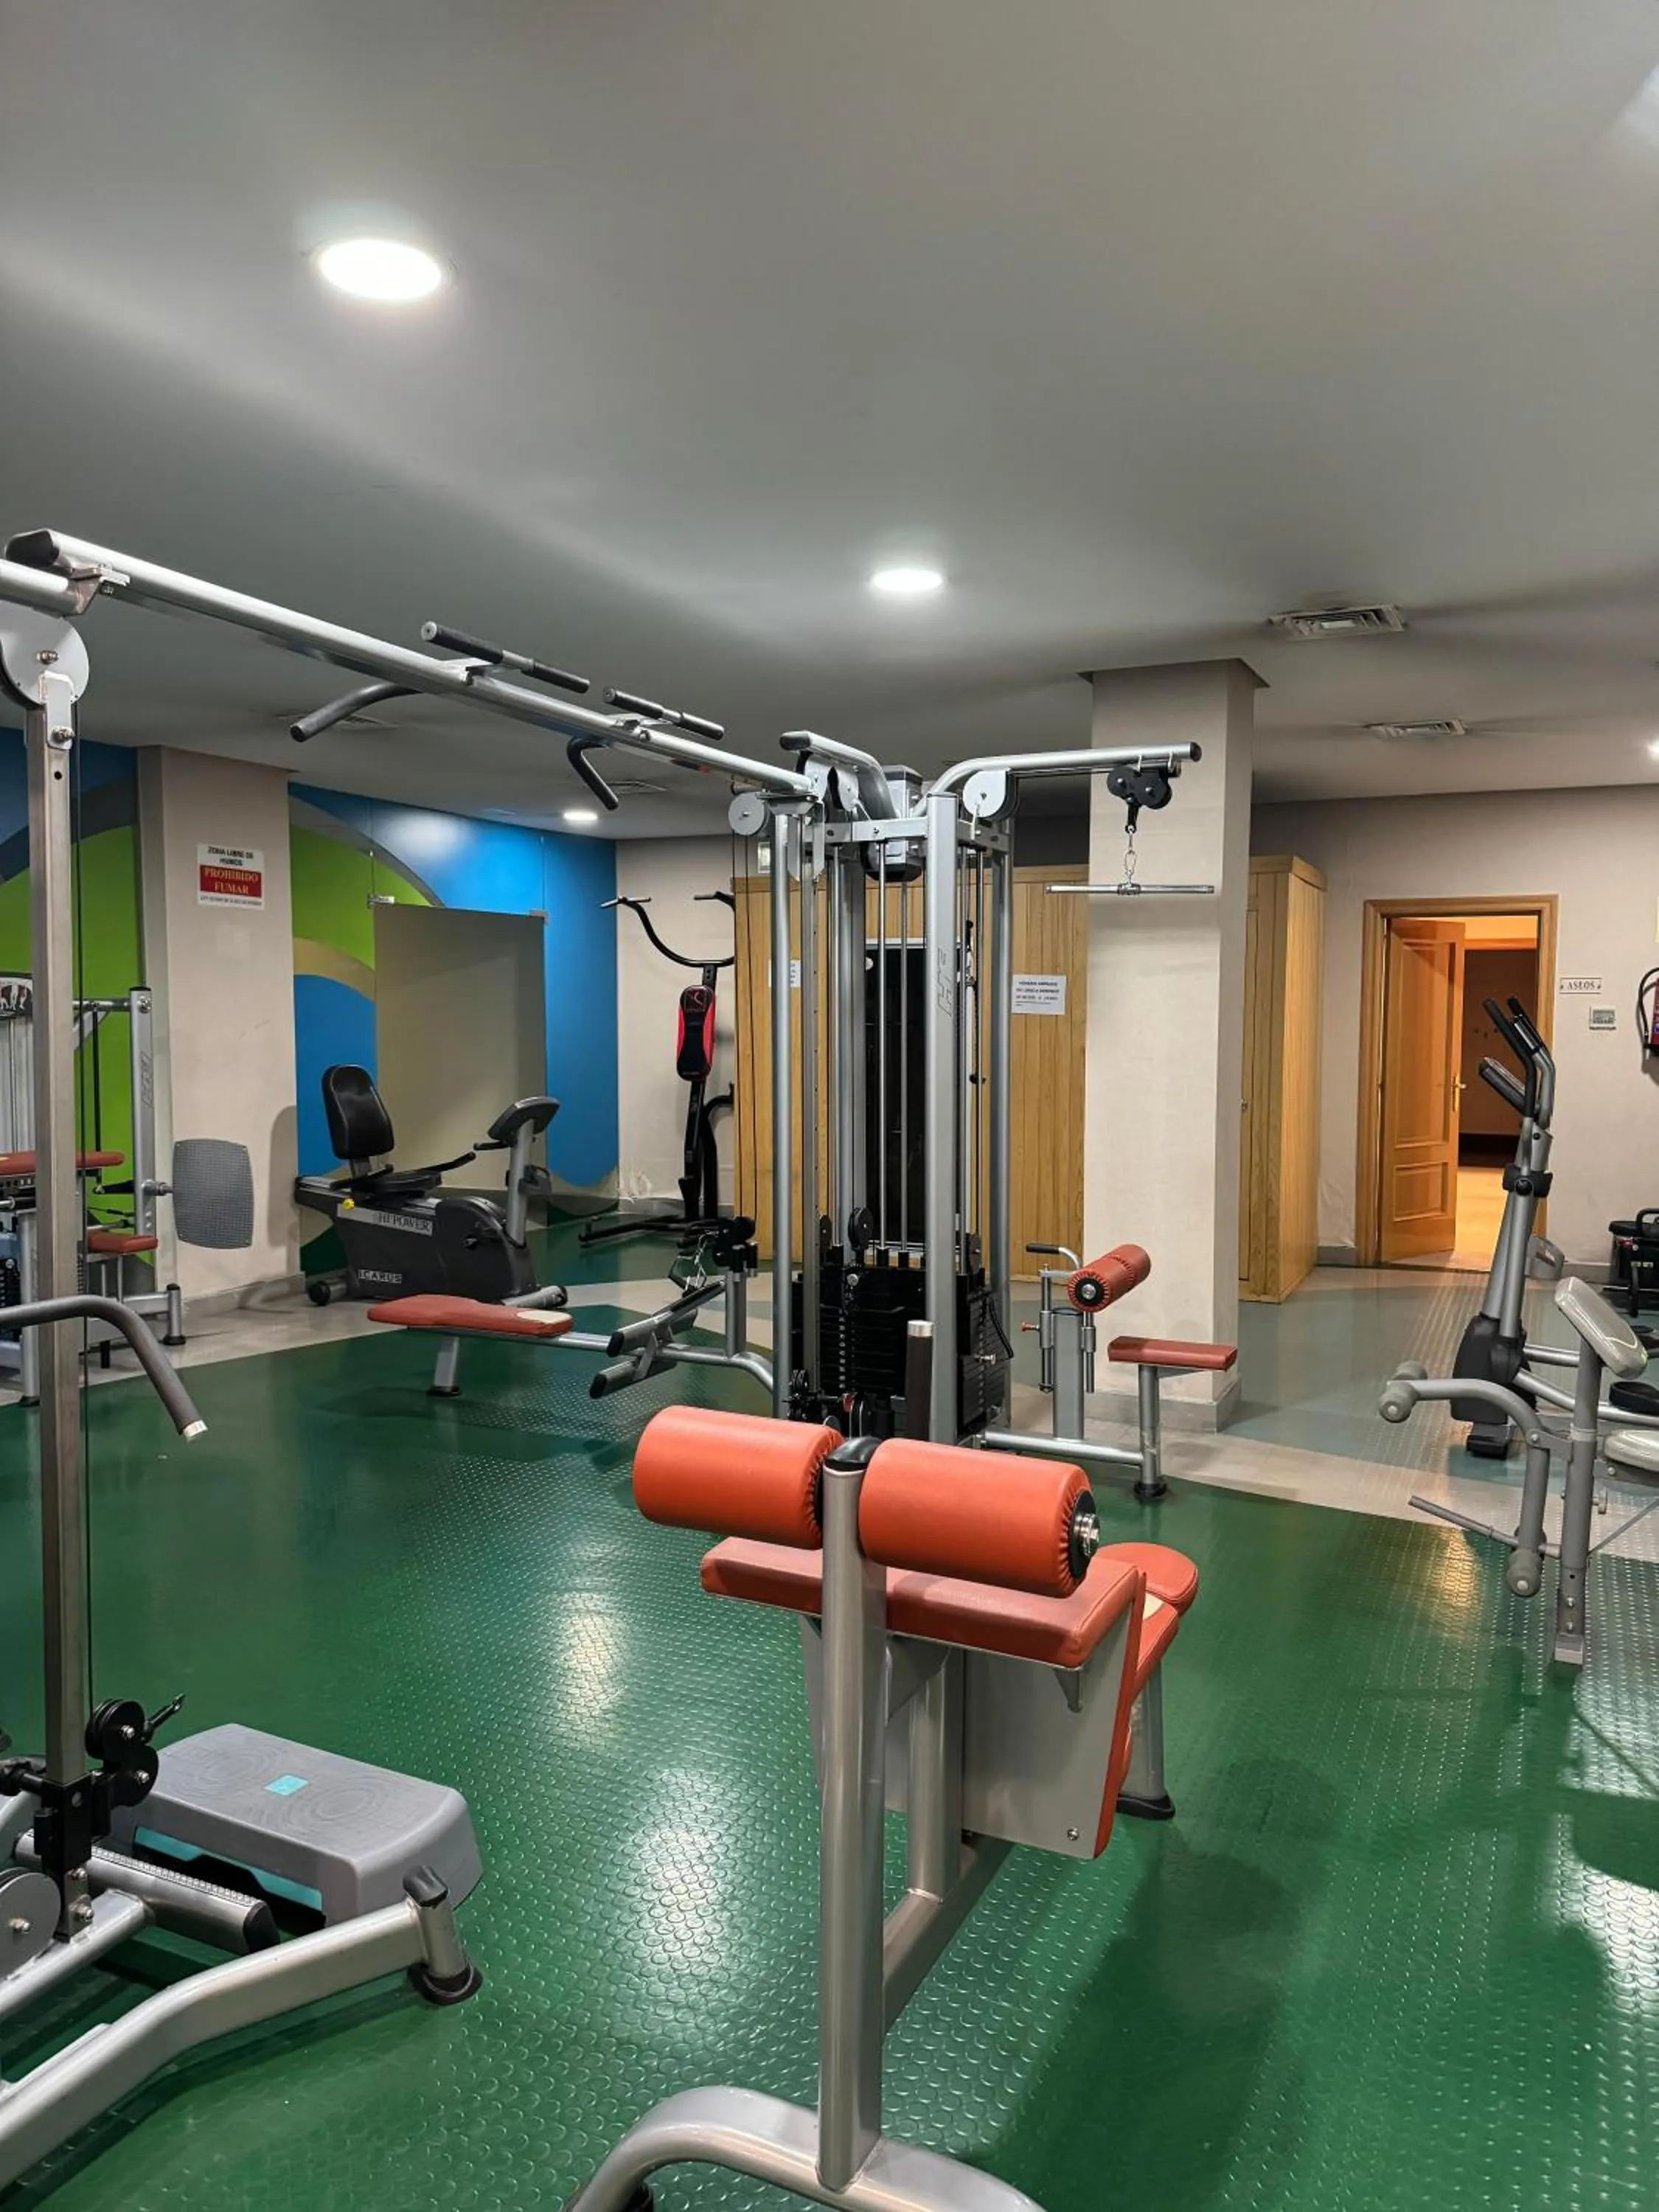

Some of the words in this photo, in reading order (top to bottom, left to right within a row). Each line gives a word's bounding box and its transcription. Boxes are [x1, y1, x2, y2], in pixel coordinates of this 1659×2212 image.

[204, 867, 259, 883] PROHIBIDO
[214, 881, 248, 894] FUMAR
[1568, 980, 1595, 990] ASEOS
